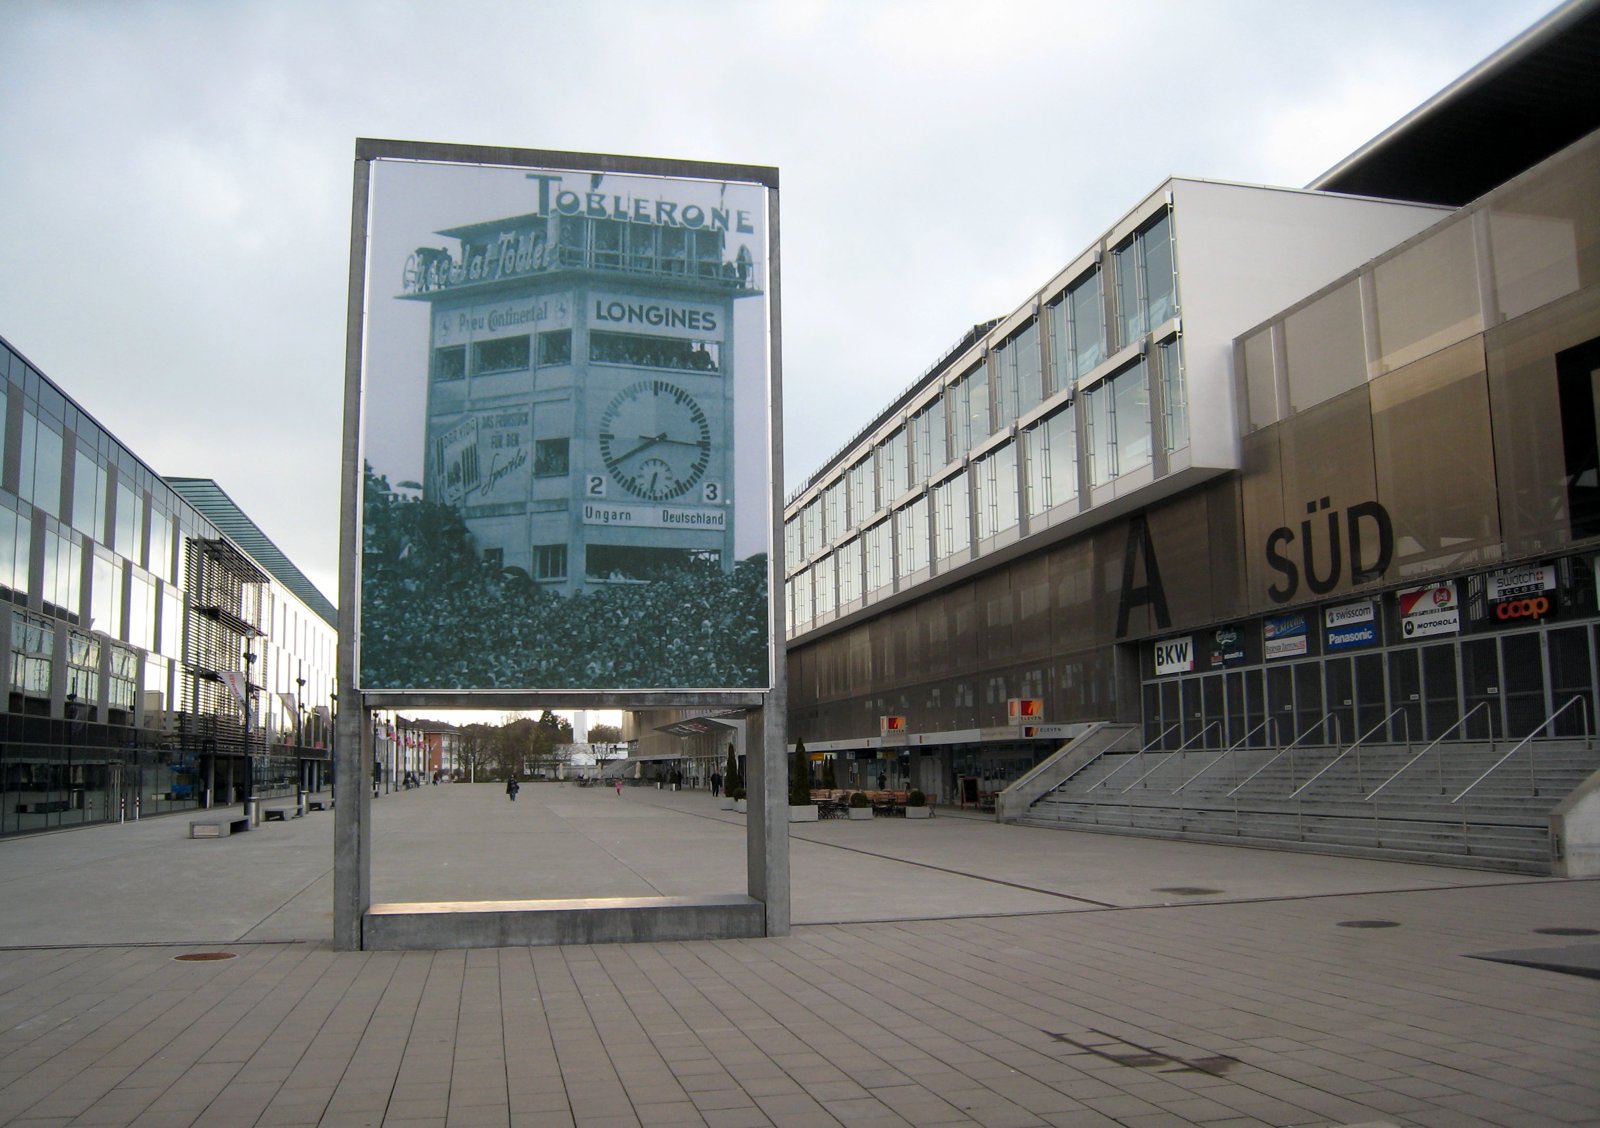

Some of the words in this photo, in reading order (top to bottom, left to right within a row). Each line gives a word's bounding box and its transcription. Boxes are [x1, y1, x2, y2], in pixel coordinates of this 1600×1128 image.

[526, 173, 754, 234] TOBLERONE
[495, 230, 556, 280] Tobler
[488, 301, 548, 331] Continental
[596, 300, 717, 332] LONGINES
[590, 476, 603, 495] 2
[706, 483, 718, 501] 3
[585, 505, 632, 523] Ungarn
[662, 508, 724, 526] Deutschland
[1266, 496, 1394, 603] SÜD
[1497, 569, 1537, 589] swatch
[1498, 582, 1545, 597] access
[1335, 606, 1371, 621] swisscom
[1497, 597, 1549, 619] coop
[1416, 617, 1457, 630] MOTOROLA
[1329, 628, 1373, 645] Panasonic
[1157, 641, 1189, 667] BKW
